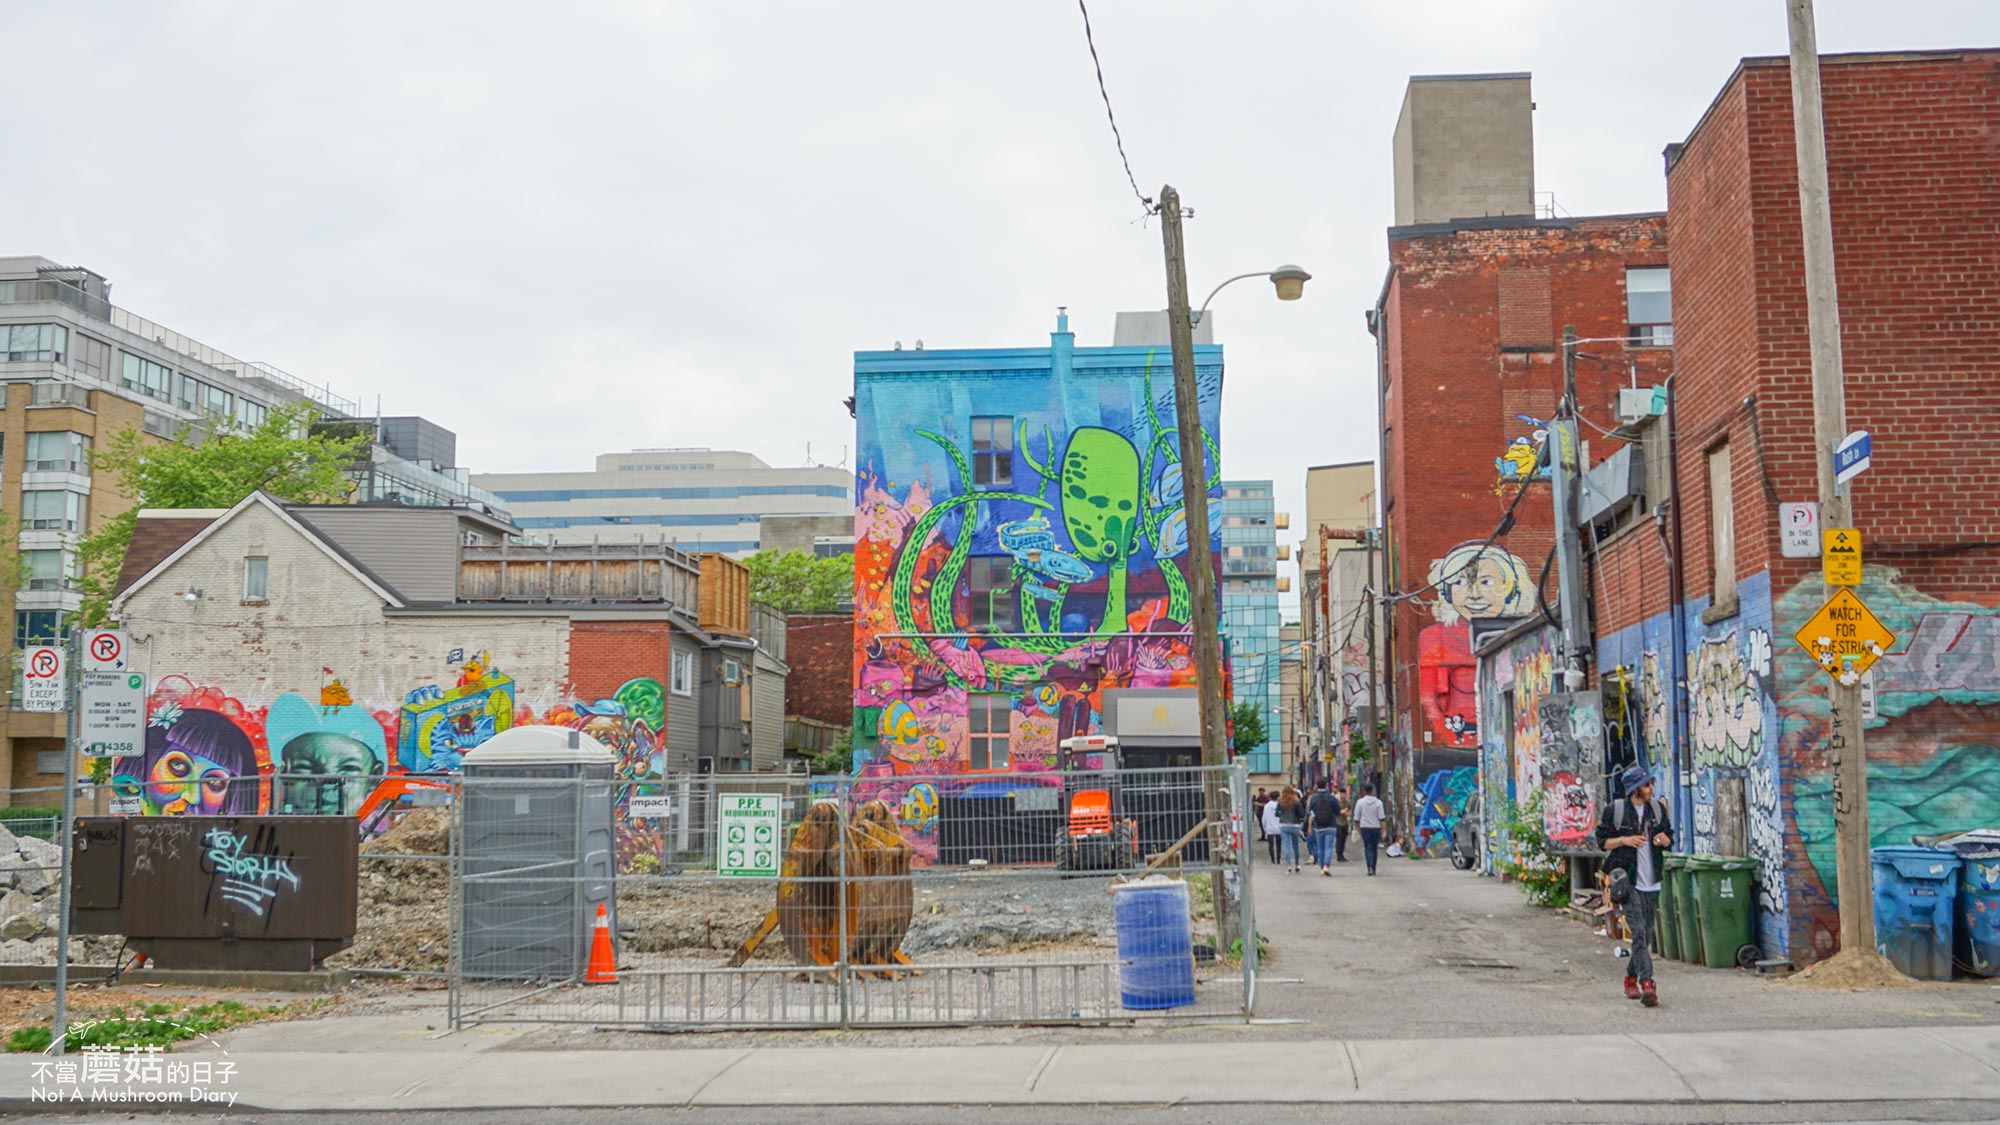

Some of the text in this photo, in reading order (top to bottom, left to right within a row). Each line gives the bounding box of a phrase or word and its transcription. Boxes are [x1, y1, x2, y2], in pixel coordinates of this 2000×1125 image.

[1829, 607, 1862, 621] WATCH
[1835, 623, 1857, 637] FOR
[30, 690, 58, 698] EXCEPT
[106, 743, 133, 751] 4358
[111, 798, 140, 806] impact
[631, 798, 668, 807] impact
